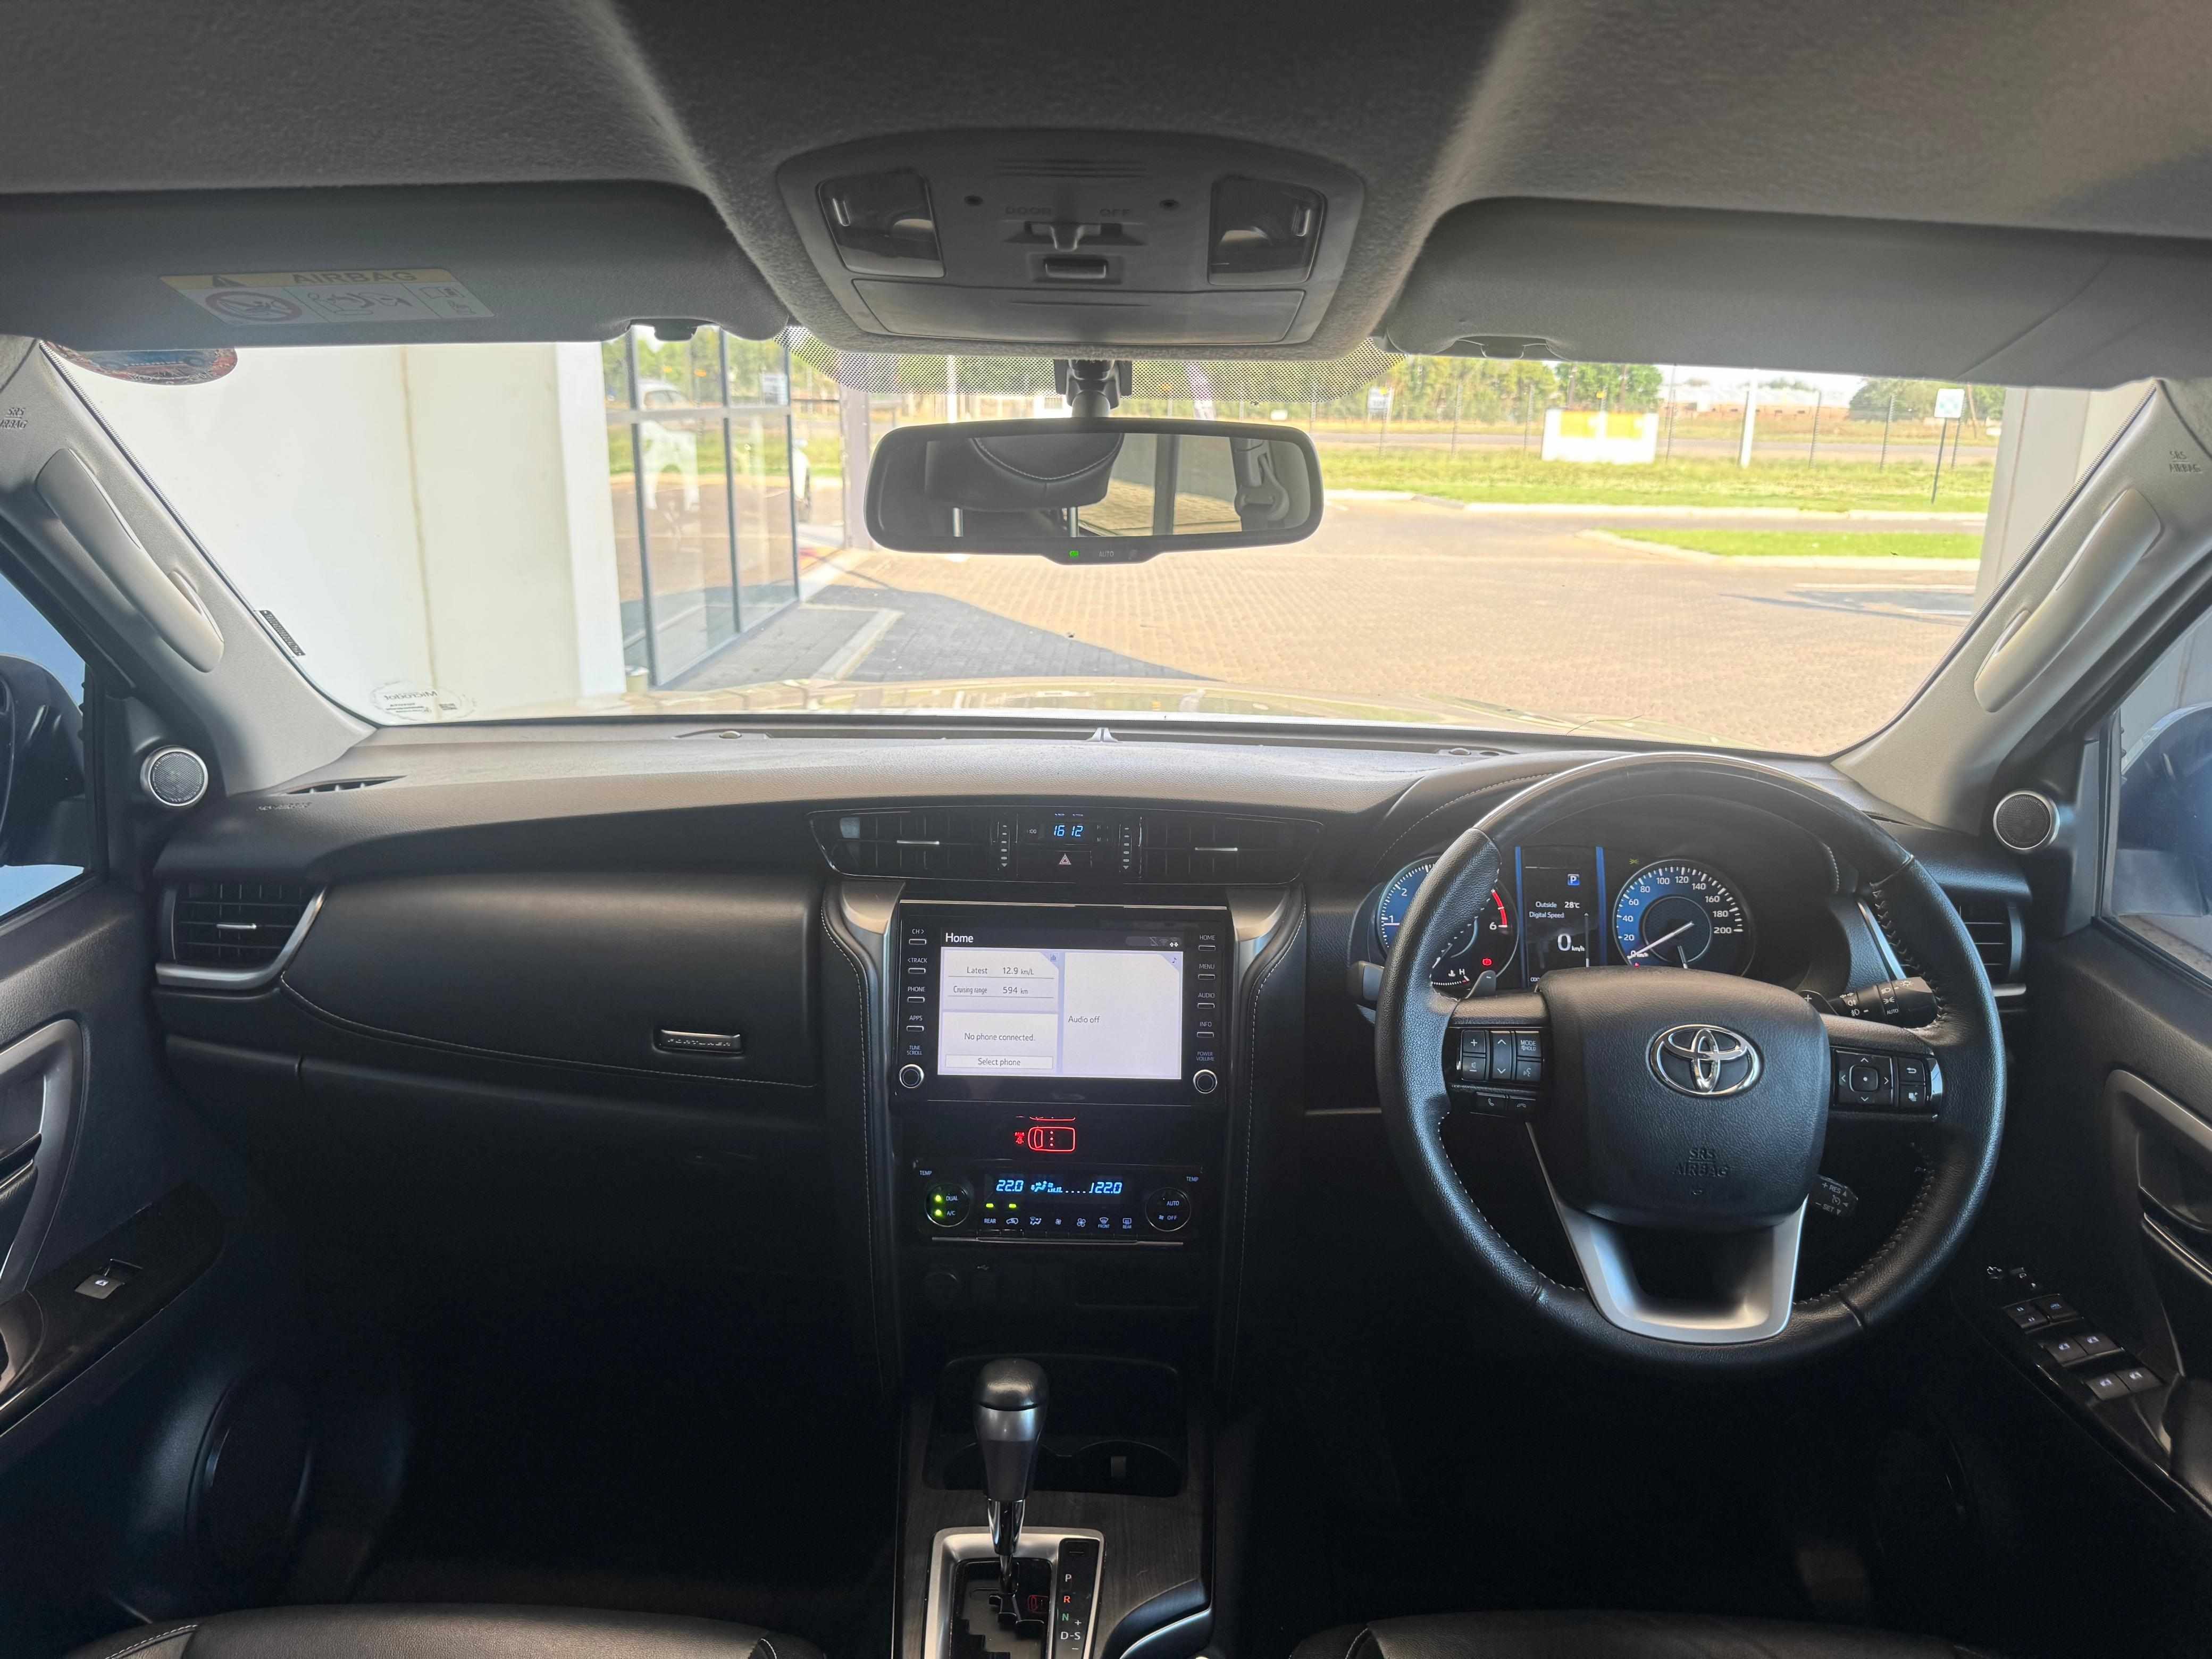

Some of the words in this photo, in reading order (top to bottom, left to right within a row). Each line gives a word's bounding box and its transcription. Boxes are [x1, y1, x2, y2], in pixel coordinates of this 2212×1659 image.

[292, 271, 417, 284] AIRBAG
[1401, 888, 1407, 896] 2
[1489, 921, 1497, 930] 6
[945, 932, 974, 943] Home
[1557, 933, 1572, 951] 0
[953, 985, 973, 995] Cruising
[976, 1033, 998, 1042] phone
[1000, 1058, 1021, 1067] phone
[996, 1179, 1024, 1192] 22.0
[1829, 1185, 1841, 1194] RES
[1823, 1204, 1834, 1212] SET
[1065, 1574, 1073, 1582] P
[1063, 1595, 1070, 1604] R
